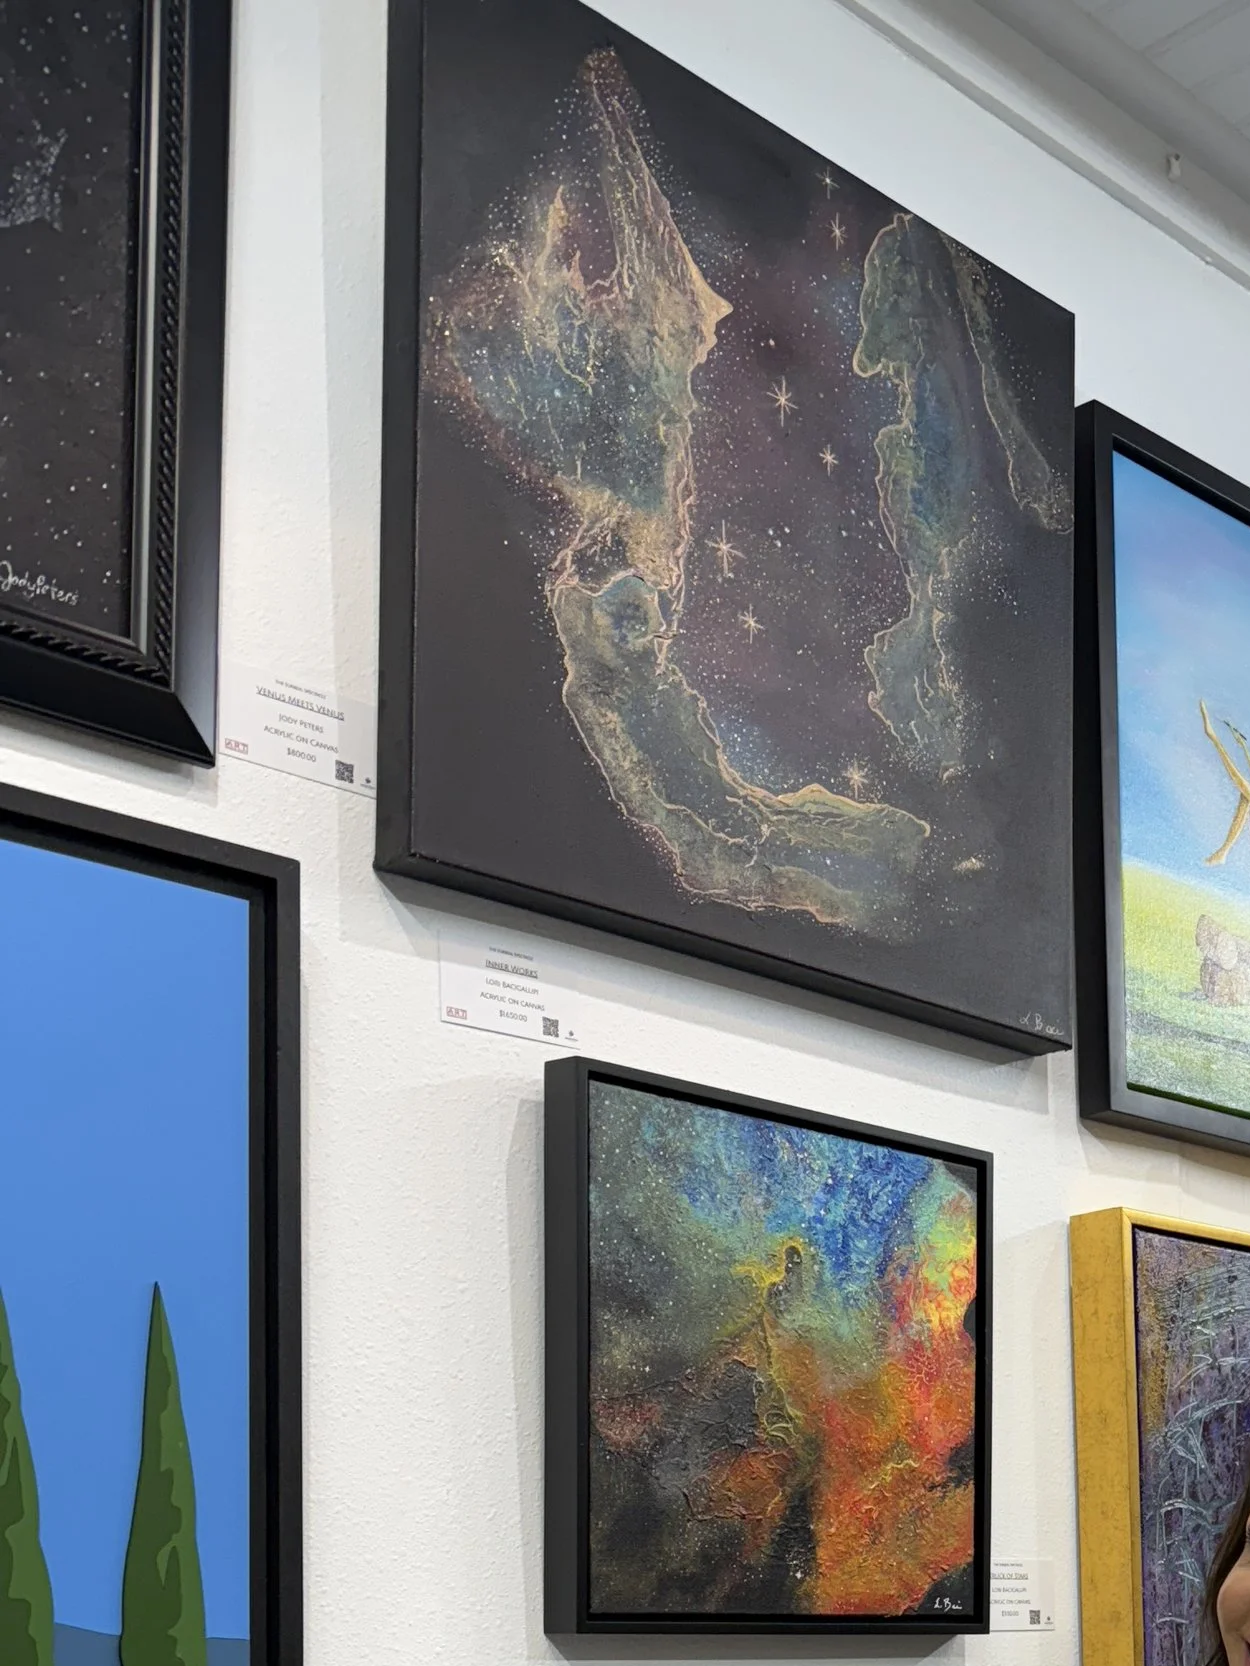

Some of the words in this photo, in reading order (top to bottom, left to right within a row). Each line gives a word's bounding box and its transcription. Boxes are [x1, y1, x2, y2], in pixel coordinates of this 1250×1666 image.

[256, 685, 286, 703] VENUS
[288, 696, 314, 711] MEETS
[316, 704, 345, 721] VENUS
[279, 713, 298, 725] JODY
[299, 719, 324, 734] PETERS
[225, 738, 249, 754] ART
[263, 725, 293, 741] ACRYLIC
[295, 735, 308, 744] ON
[310, 739, 339, 754] CANVAS
[287, 747, 317, 762] $800.00
[485, 959, 509, 972] INNER
[510, 964, 538, 979] WORKS
[480, 991, 506, 1003] ACRYLIC
[508, 997, 519, 1005] ON
[520, 999, 545, 1011] CANVAS
